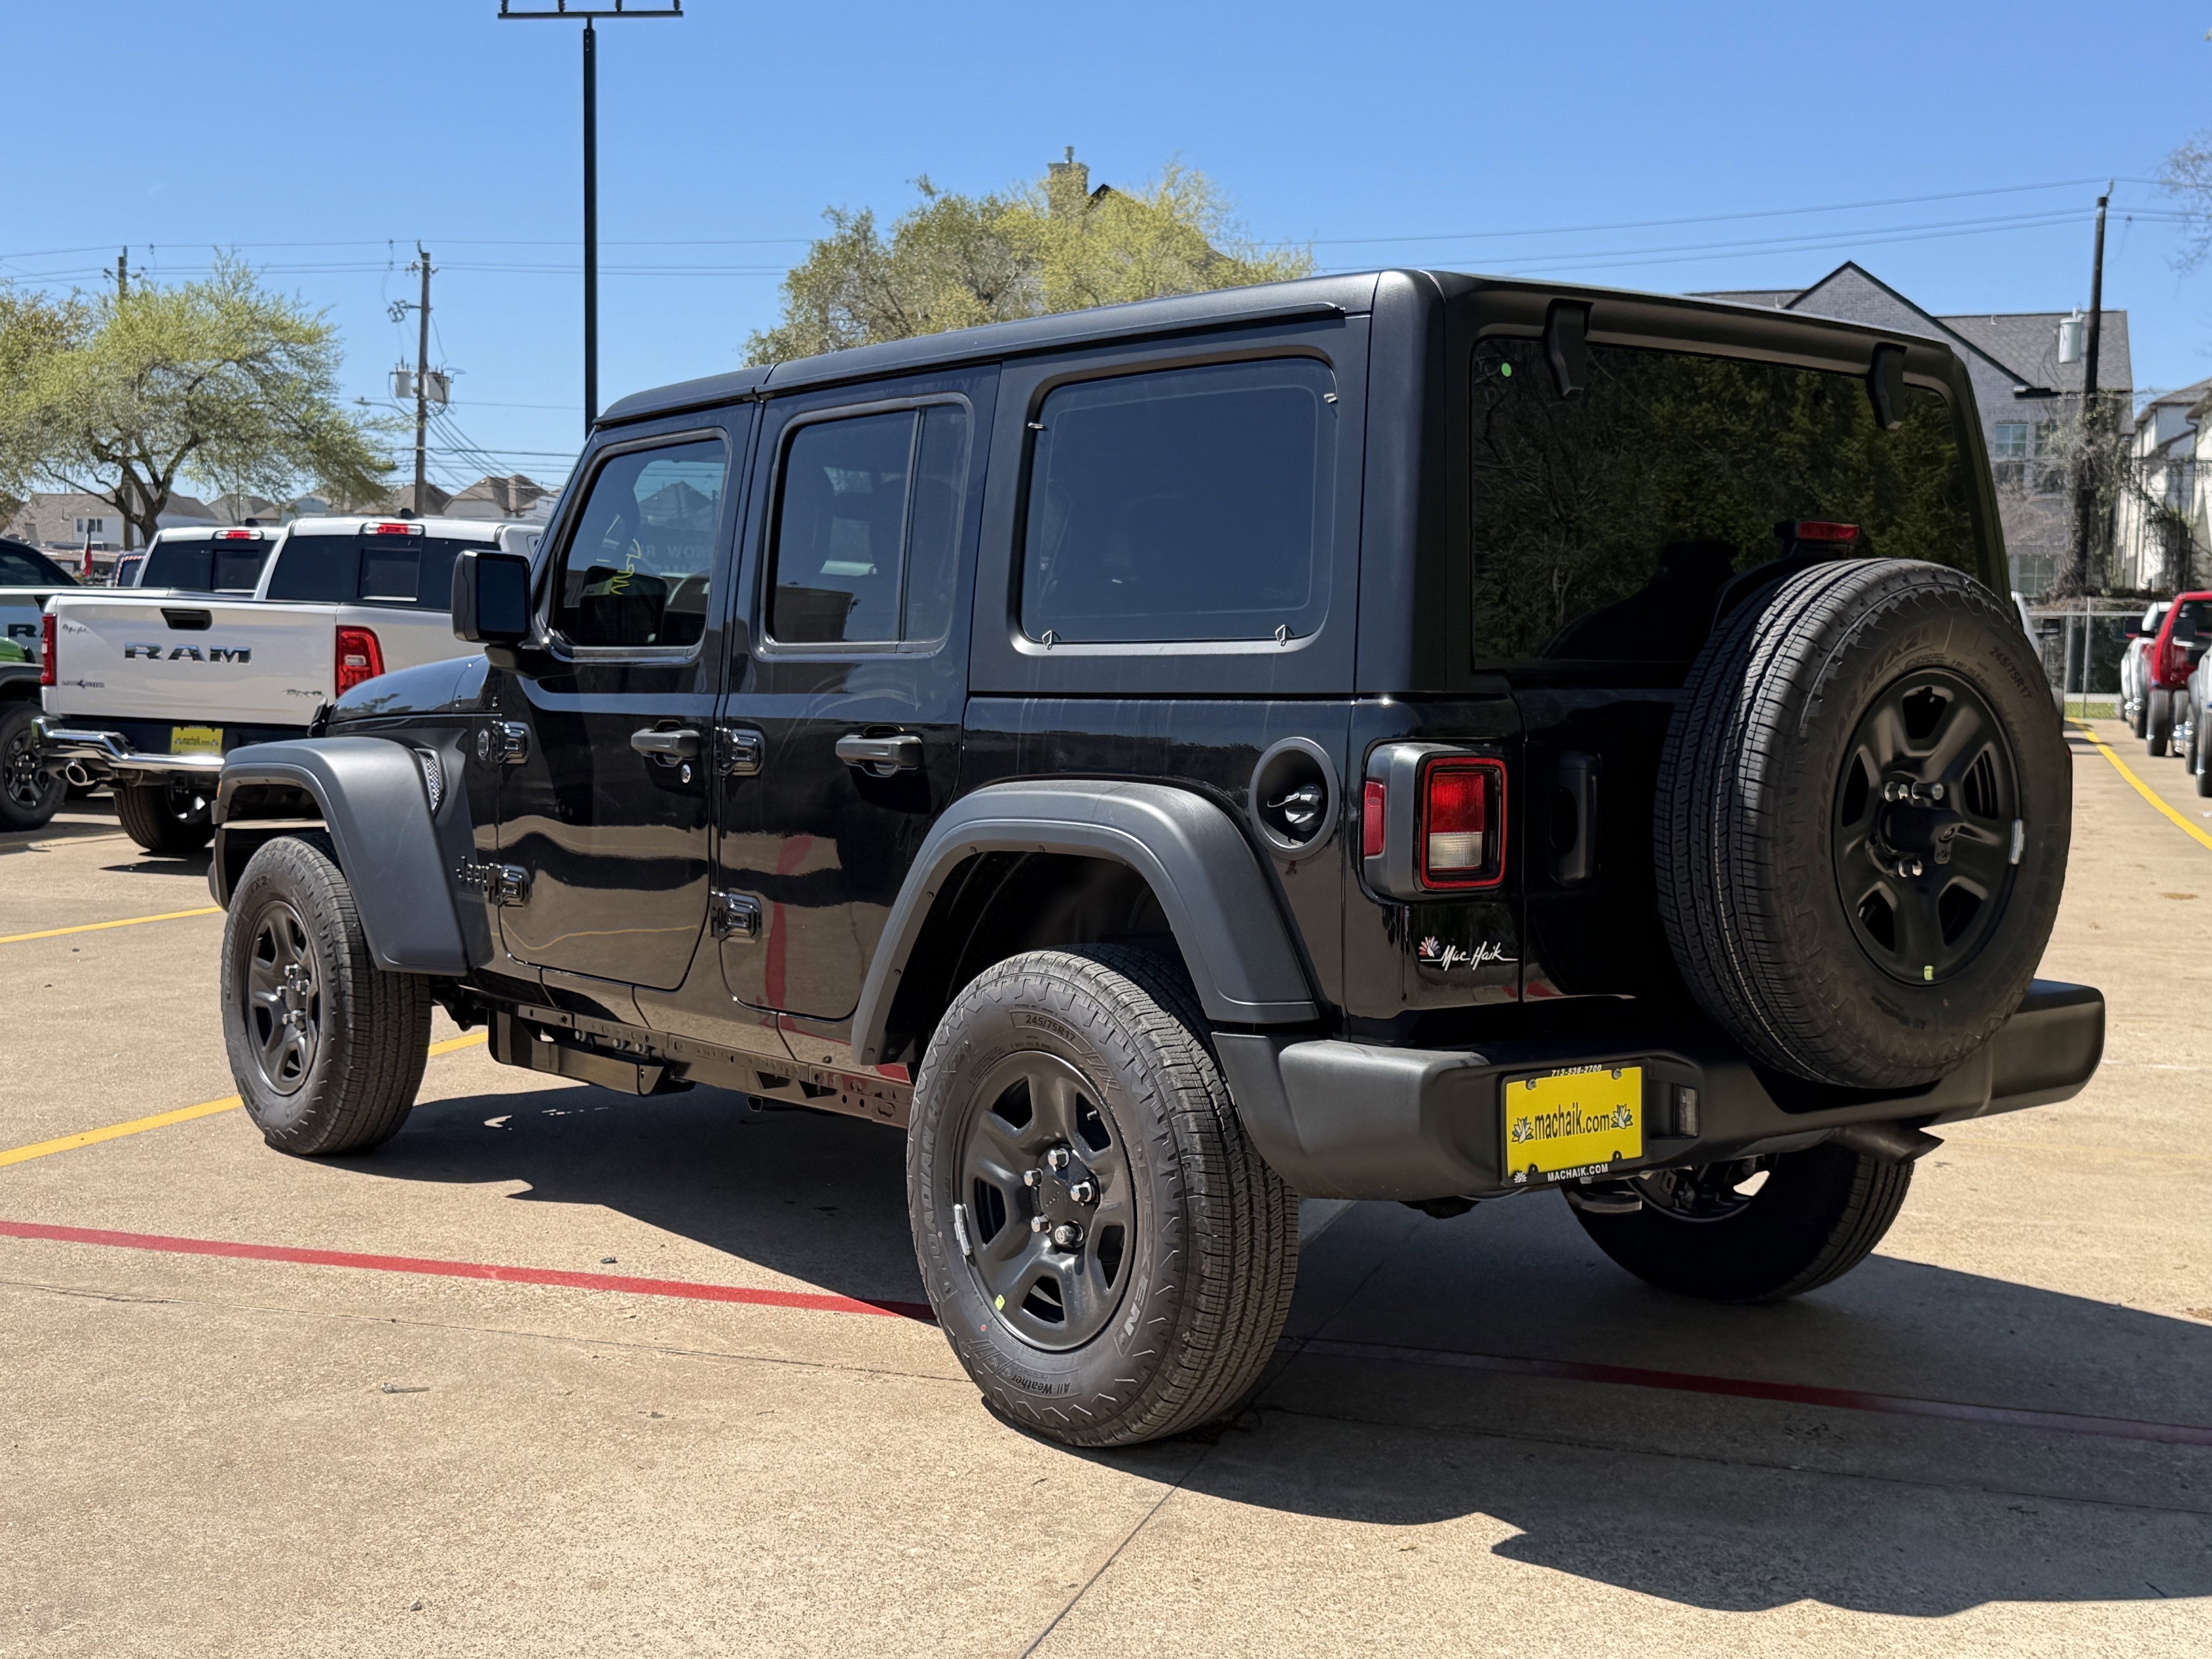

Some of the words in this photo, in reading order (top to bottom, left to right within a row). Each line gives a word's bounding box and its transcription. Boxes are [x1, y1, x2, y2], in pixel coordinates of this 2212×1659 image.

[125, 642, 252, 665] RAM
[456, 855, 490, 891] Jeep
[1436, 945, 1470, 971] Mac
[1470, 941, 1516, 970] Haik
[1026, 1015, 1076, 1042] 245/75R17
[1534, 1102, 1610, 1141] machaik.com
[1547, 1163, 1608, 1182] MACHAIK.COM
[1124, 1165, 1152, 1336] NEXEN
